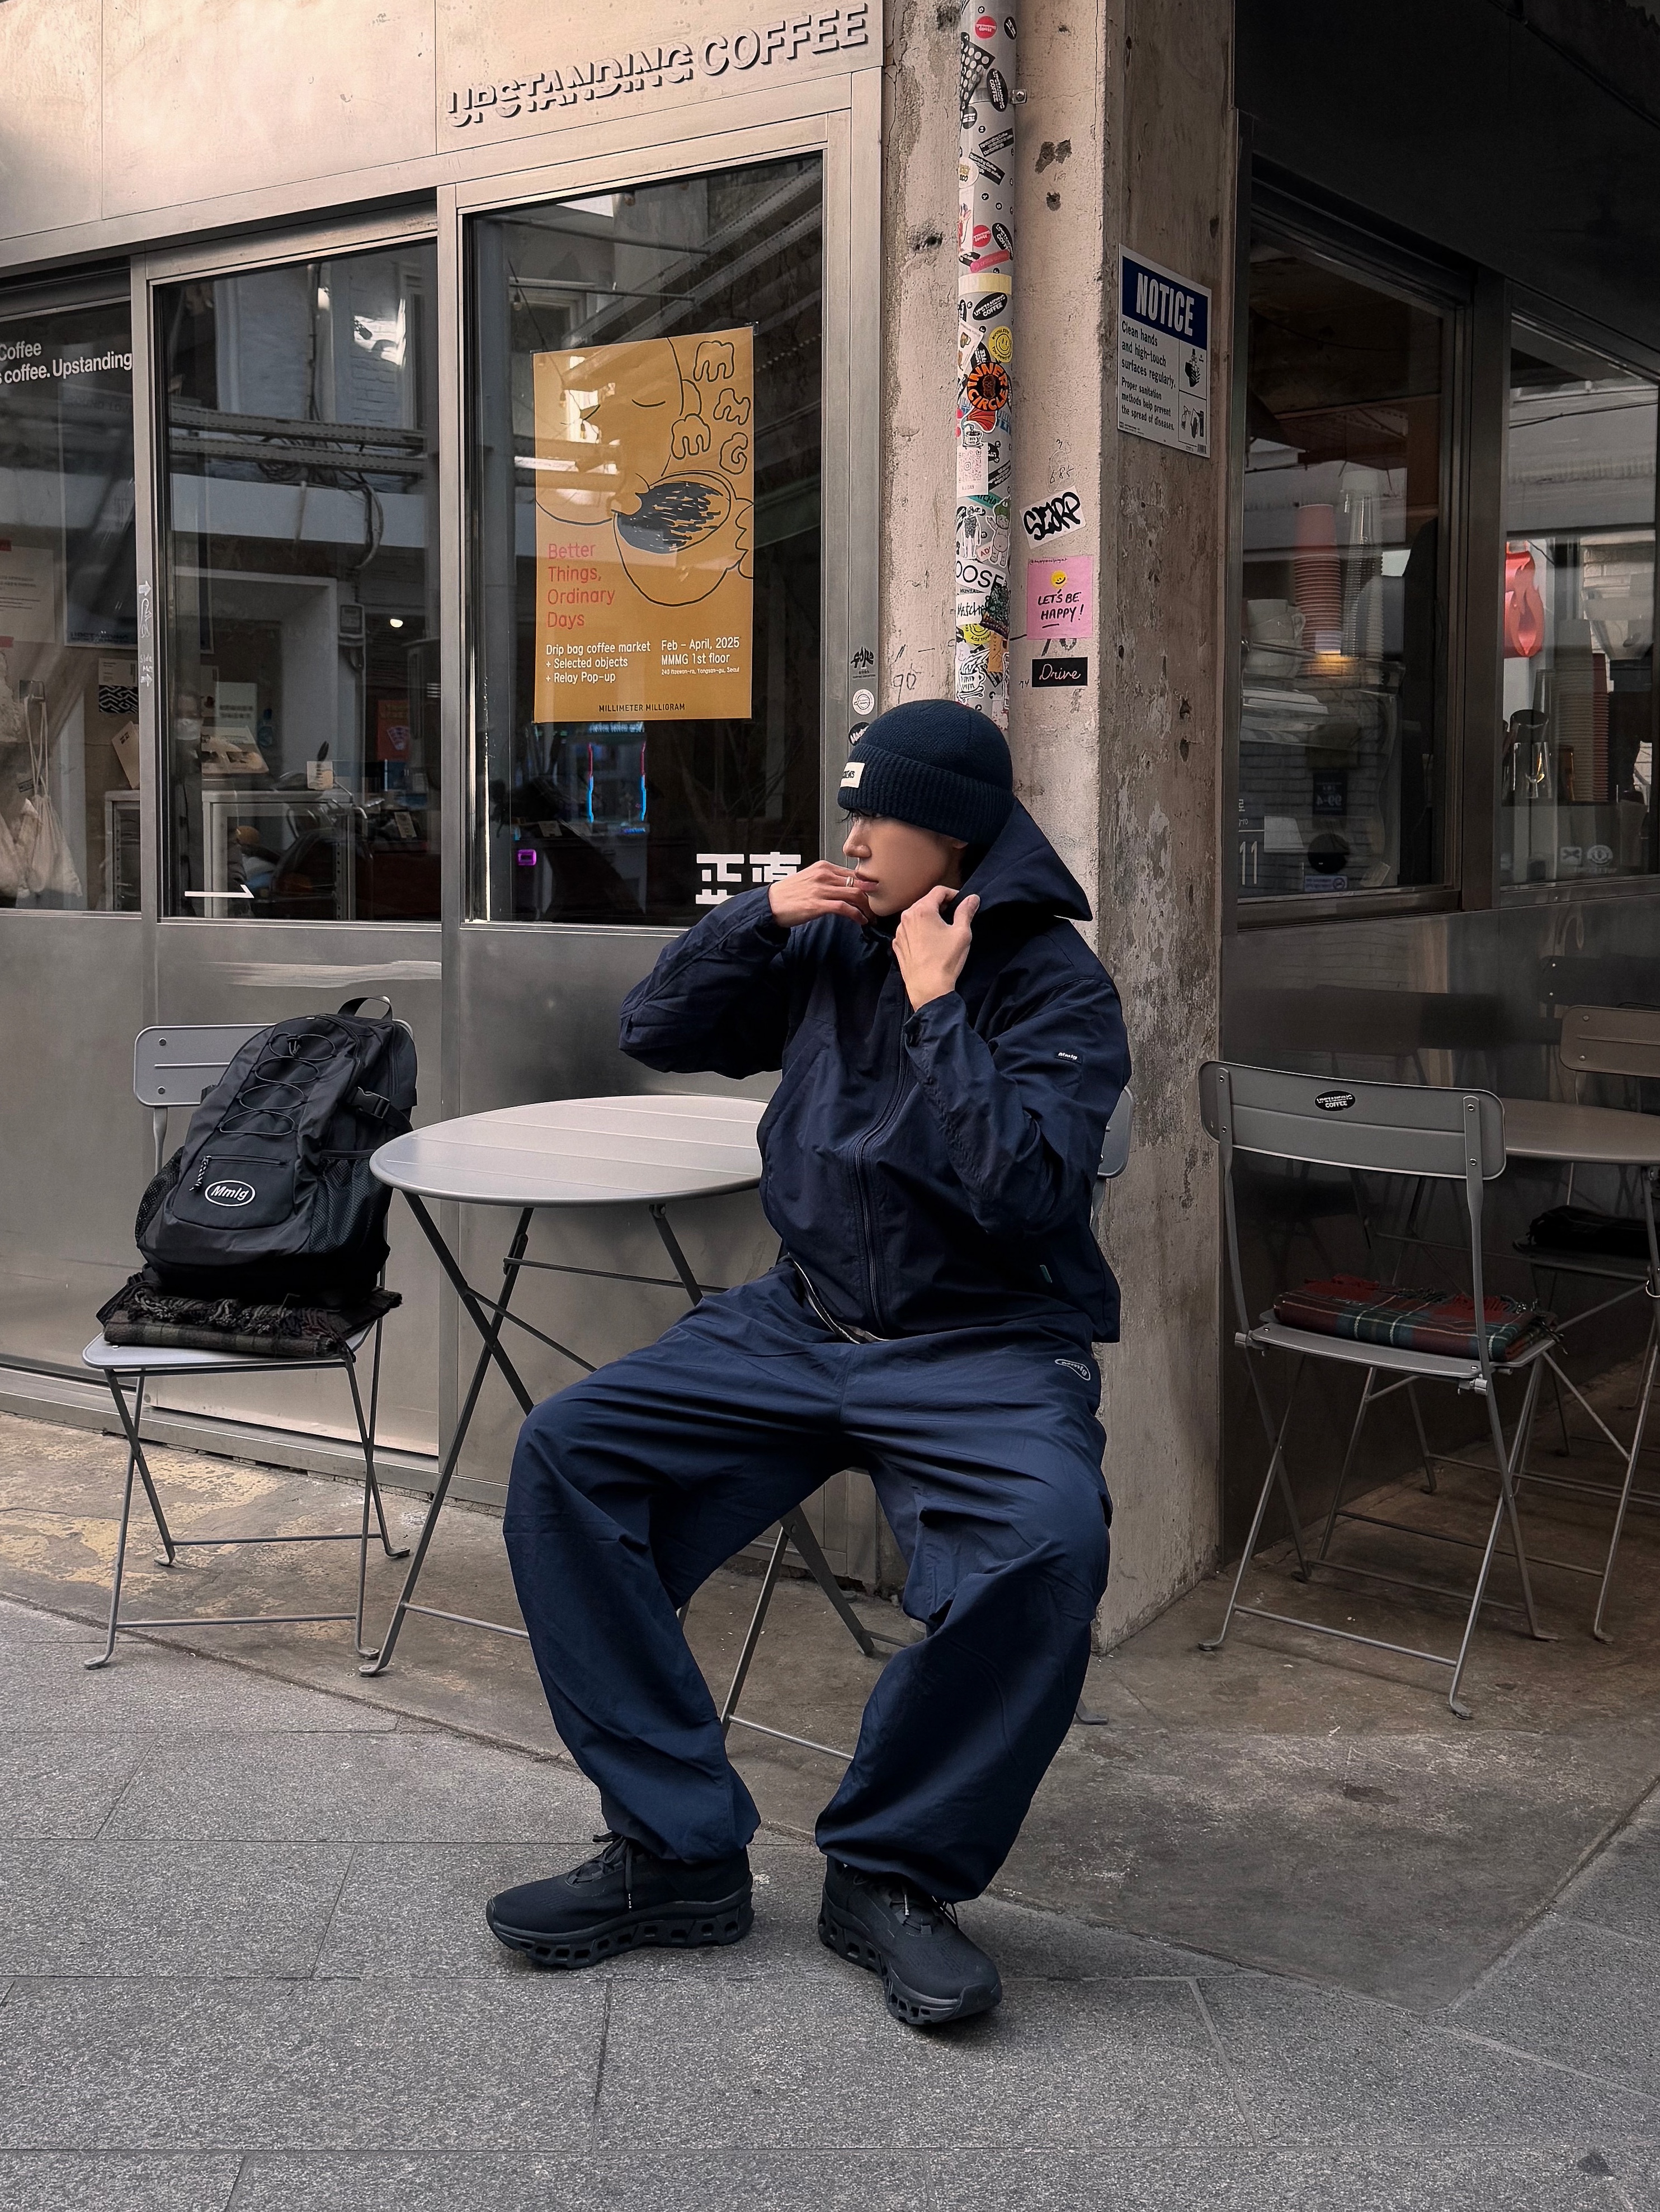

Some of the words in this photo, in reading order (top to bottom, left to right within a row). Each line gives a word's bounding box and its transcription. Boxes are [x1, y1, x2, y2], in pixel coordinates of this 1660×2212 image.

[449, 44, 694, 128] UPSTANDING
[704, 3, 869, 76] COFFEE
[983, 303, 1003, 316] COFFEE
[1136, 272, 1195, 336] NOTICE
[1121, 320, 1139, 338] Clean
[1140, 332, 1158, 347] hands
[0, 341, 42, 361] Coffee
[1121, 340, 1133, 354] and
[1135, 344, 1166, 367] high-touch
[4, 363, 50, 384] coffee.
[53, 351, 133, 379] Upstanding
[968, 362, 1008, 387] INNER
[1121, 358, 1147, 377] surfaces
[1149, 371, 1176, 389] regularly.
[1121, 376, 1138, 393] Proper
[1139, 383, 1162, 400] sanitation
[968, 388, 1008, 410] CIRCLE
[1121, 393, 1142, 406] methods
[1143, 398, 1153, 410] help
[1154, 404, 1171, 417] prevent
[1121, 404, 1130, 415] the
[1131, 409, 1147, 423] spread
[1148, 415, 1153, 424] of
[1154, 416, 1175, 431] diseases.
[548, 542, 596, 560] Better
[548, 565, 601, 584] Things,
[548, 588, 615, 606] Ordinary
[1038, 589, 1063, 606] LET'S
[1065, 592, 1082, 604] BE
[547, 611, 585, 630] Days
[546, 644, 564, 656] Drip
[567, 644, 584, 656] bag
[587, 642, 615, 654] coffee
[619, 641, 651, 653] market
[661, 639, 678, 651] Feb
[689, 638, 713, 651] April,
[715, 636, 740, 649] 2025
[554, 657, 592, 669] Selected
[595, 656, 628, 669] objects
[661, 654, 688, 665] MMMG
[692, 653, 706, 664] 1st
[709, 652, 730, 664] floor
[554, 672, 578, 684] Relay
[581, 672, 616, 683] Pop-up
[645, 703, 685, 711] MILLIGRAM
[210, 1185, 249, 1201] Mmlg
